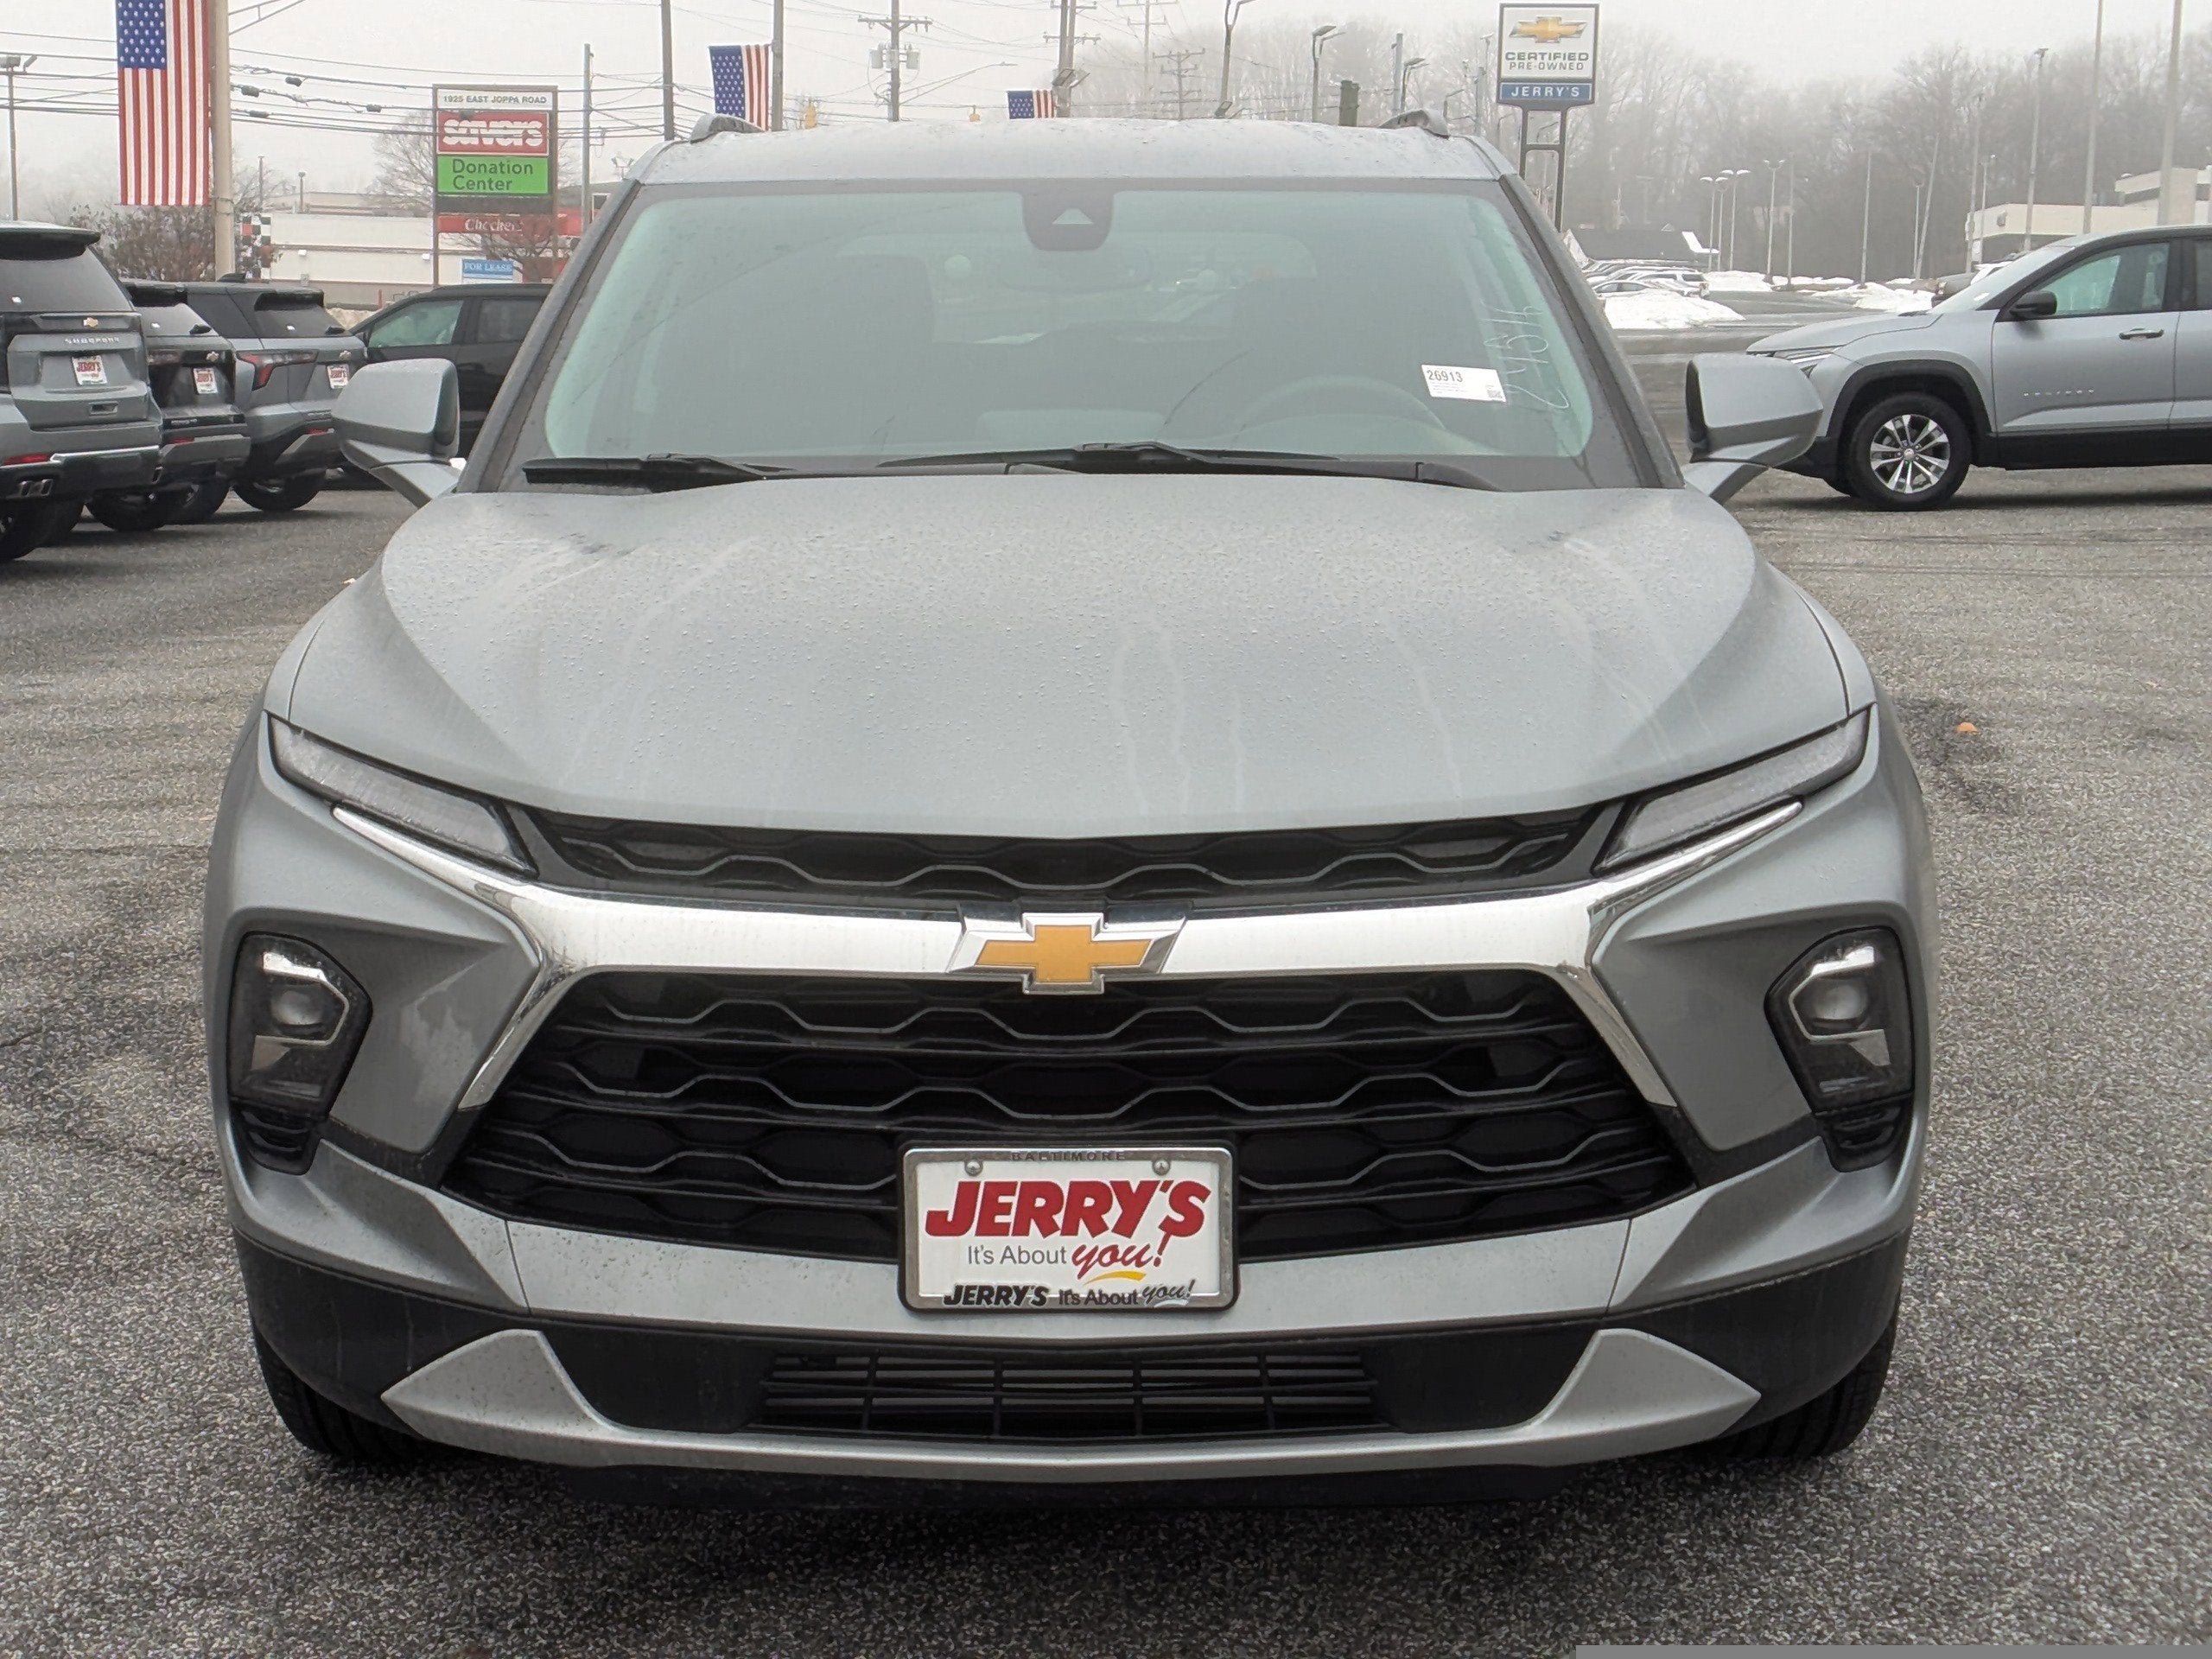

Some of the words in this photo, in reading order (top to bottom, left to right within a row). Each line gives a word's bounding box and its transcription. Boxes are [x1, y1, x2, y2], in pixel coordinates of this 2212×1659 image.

[1505, 52, 1589, 61] CERTIFIED
[1510, 61, 1584, 71] PRE-OWNED
[1510, 86, 1580, 98] JERRY'S
[452, 158, 533, 175] Donation
[452, 175, 512, 190] Center
[1427, 369, 1464, 383] 26913
[1012, 1152, 1125, 1161] BALTIMORE
[925, 1179, 1211, 1239] JERRY'S
[968, 1245, 994, 1265] It's
[1000, 1245, 1067, 1265] About
[1071, 1235, 1169, 1280] you!
[944, 1284, 1051, 1306] JERRY'S
[1058, 1288, 1080, 1306] It's
[1084, 1288, 1139, 1306] About
[1142, 1279, 1196, 1305] you!
